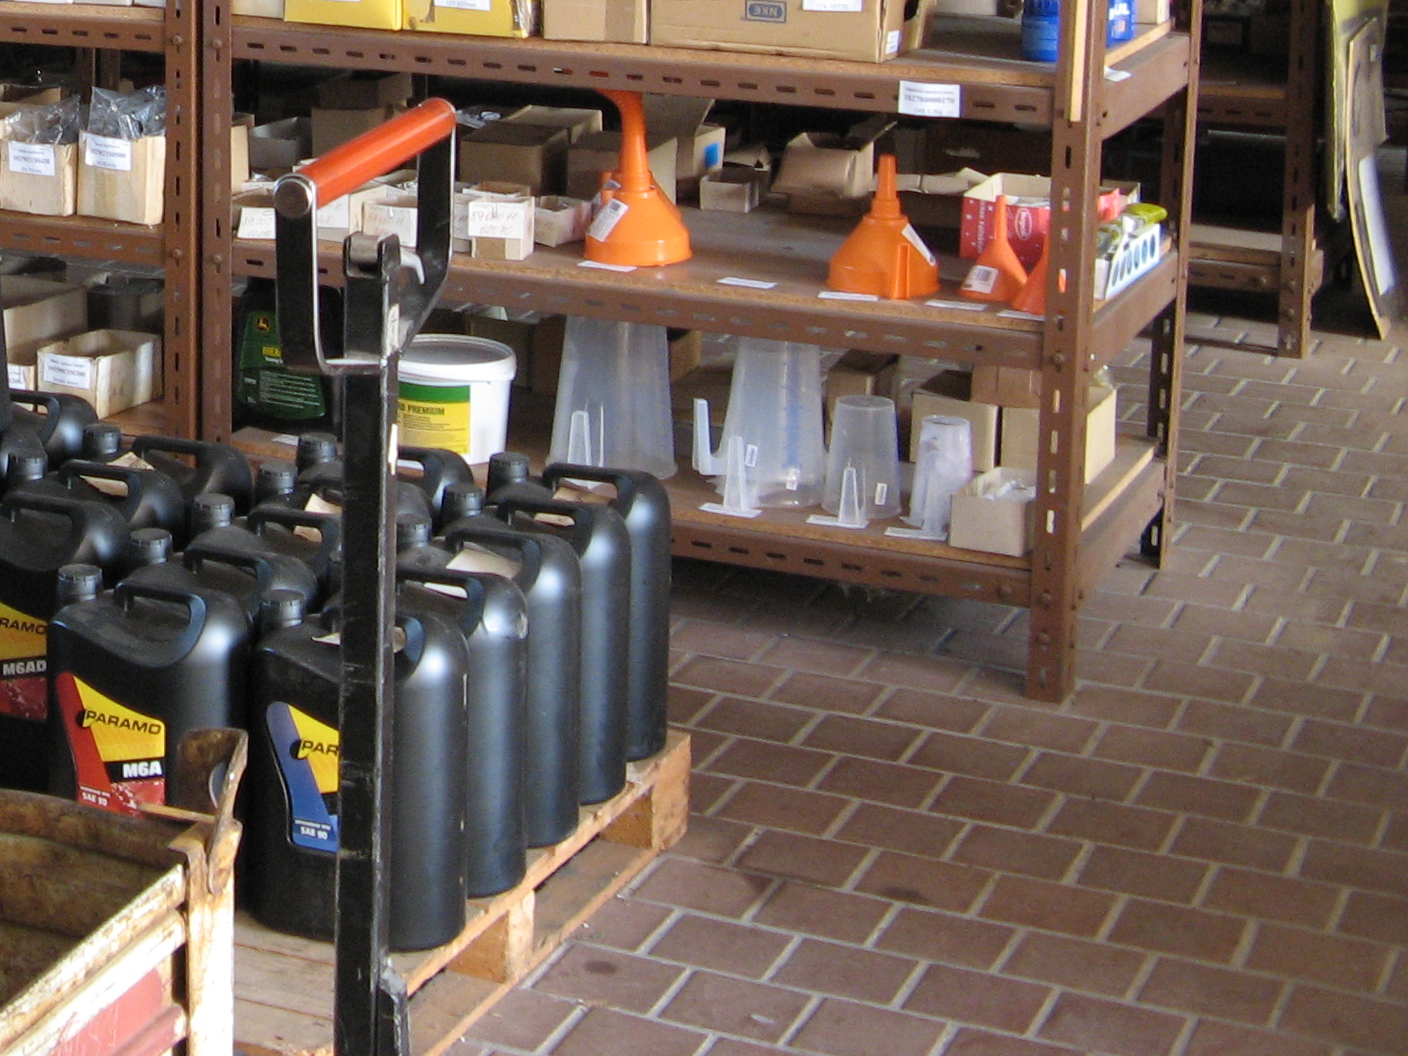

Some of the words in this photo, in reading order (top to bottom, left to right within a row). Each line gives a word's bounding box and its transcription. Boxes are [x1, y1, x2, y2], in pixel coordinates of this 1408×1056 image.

[754, 4, 778, 17] NKE
[407, 404, 445, 415] PREMIUM
[2, 659, 47, 676] M6AD
[86, 710, 162, 735] PARAMO
[301, 740, 339, 756] PAR
[122, 761, 162, 779] M6A
[300, 826, 316, 838] SAE
